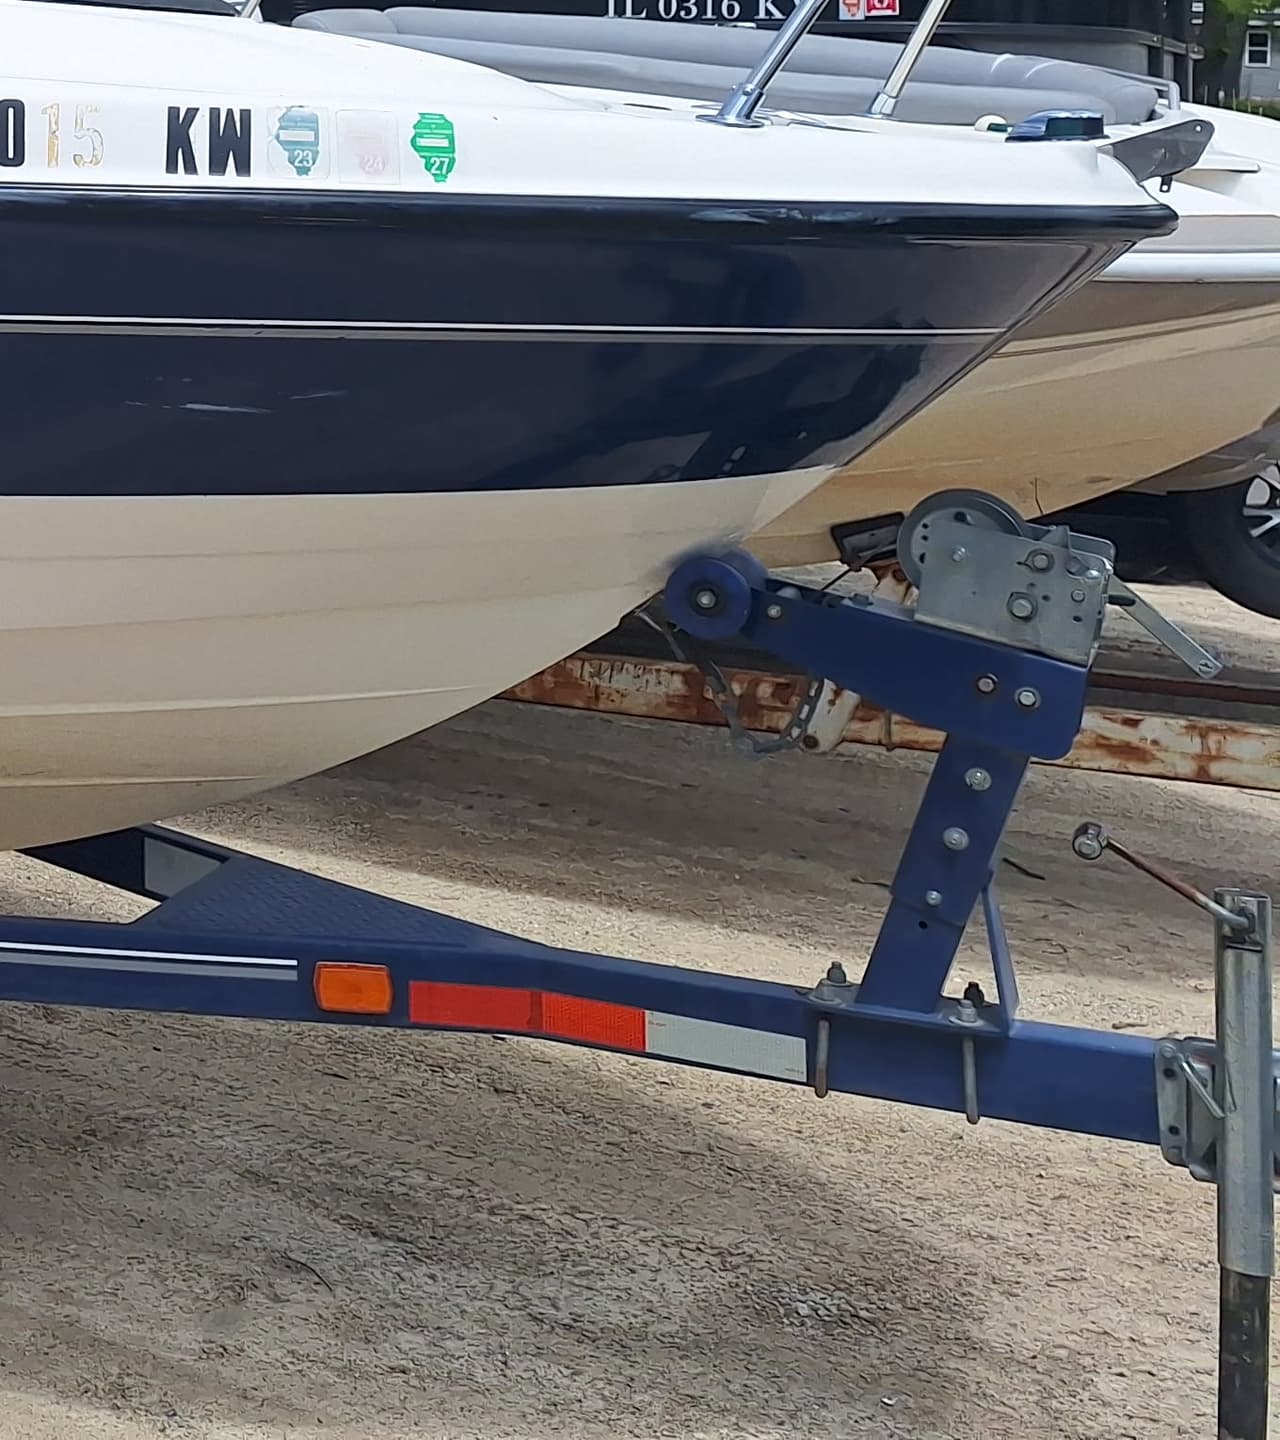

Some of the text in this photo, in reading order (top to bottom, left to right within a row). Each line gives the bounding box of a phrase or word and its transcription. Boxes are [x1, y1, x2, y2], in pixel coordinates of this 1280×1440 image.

[165, 105, 253, 177] KW
[294, 150, 315, 167] 23
[430, 157, 450, 175] 27
